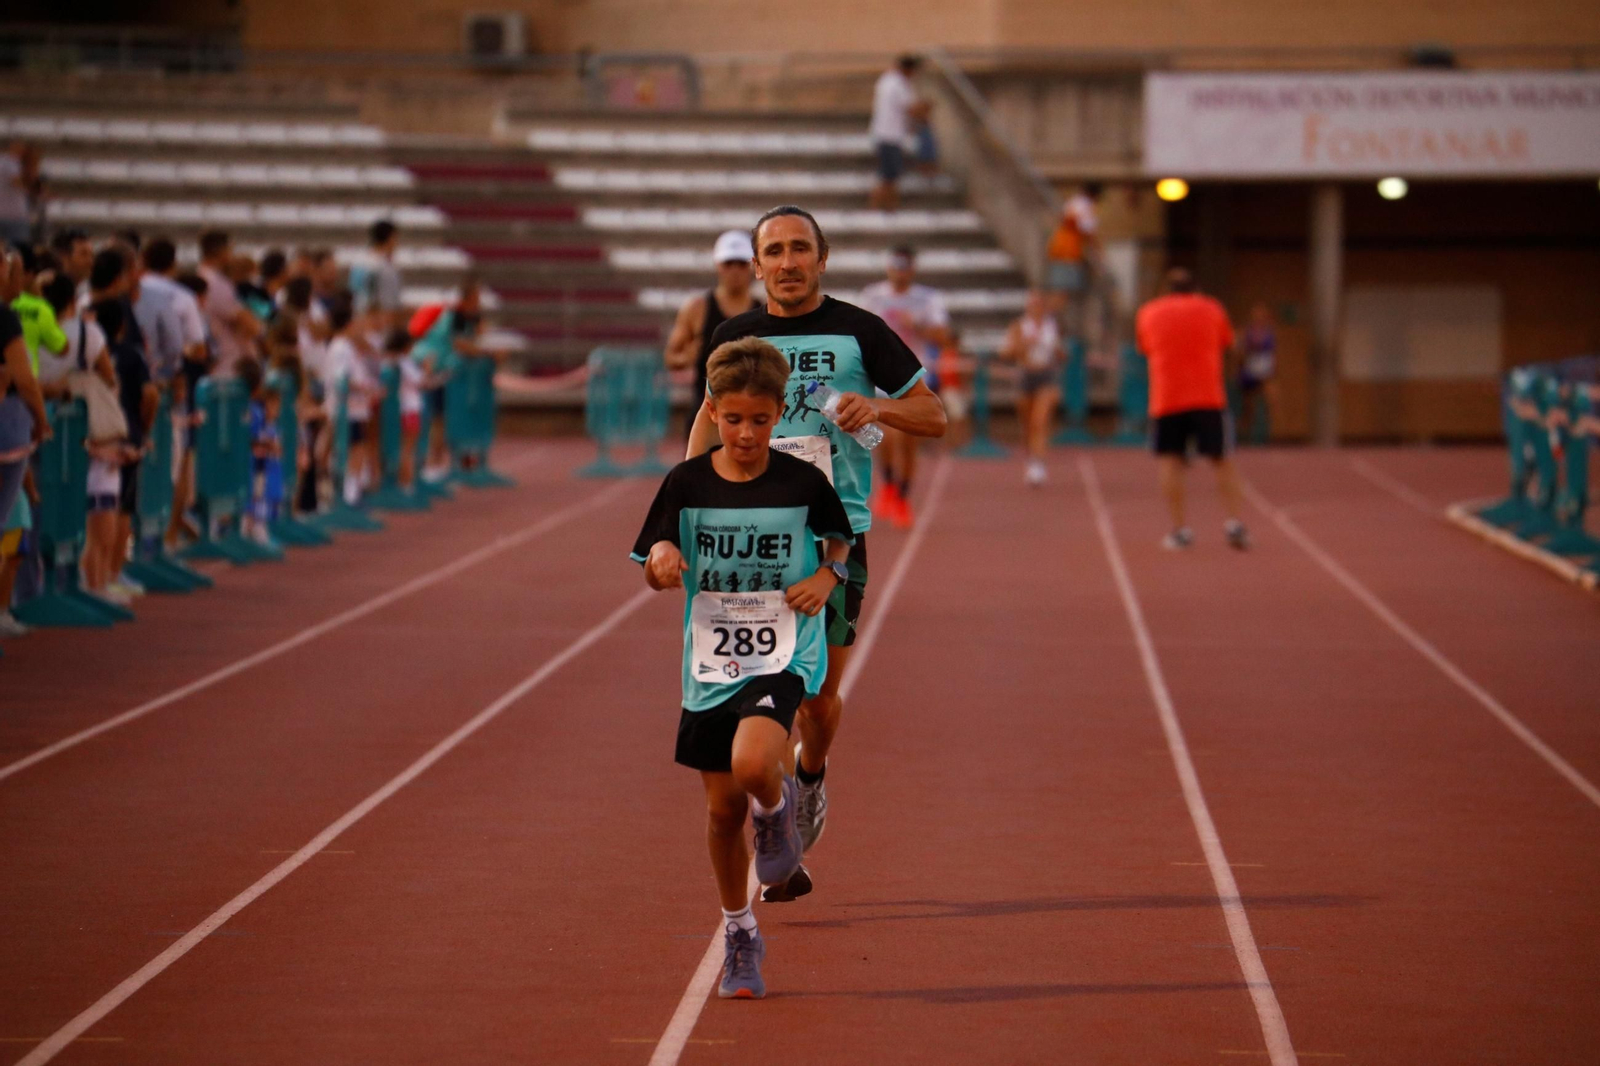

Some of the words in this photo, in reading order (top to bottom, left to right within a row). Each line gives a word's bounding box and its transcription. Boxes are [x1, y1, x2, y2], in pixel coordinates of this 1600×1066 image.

[789, 351, 836, 373] JER
[696, 531, 792, 560] MUJER
[713, 626, 777, 657] 289
